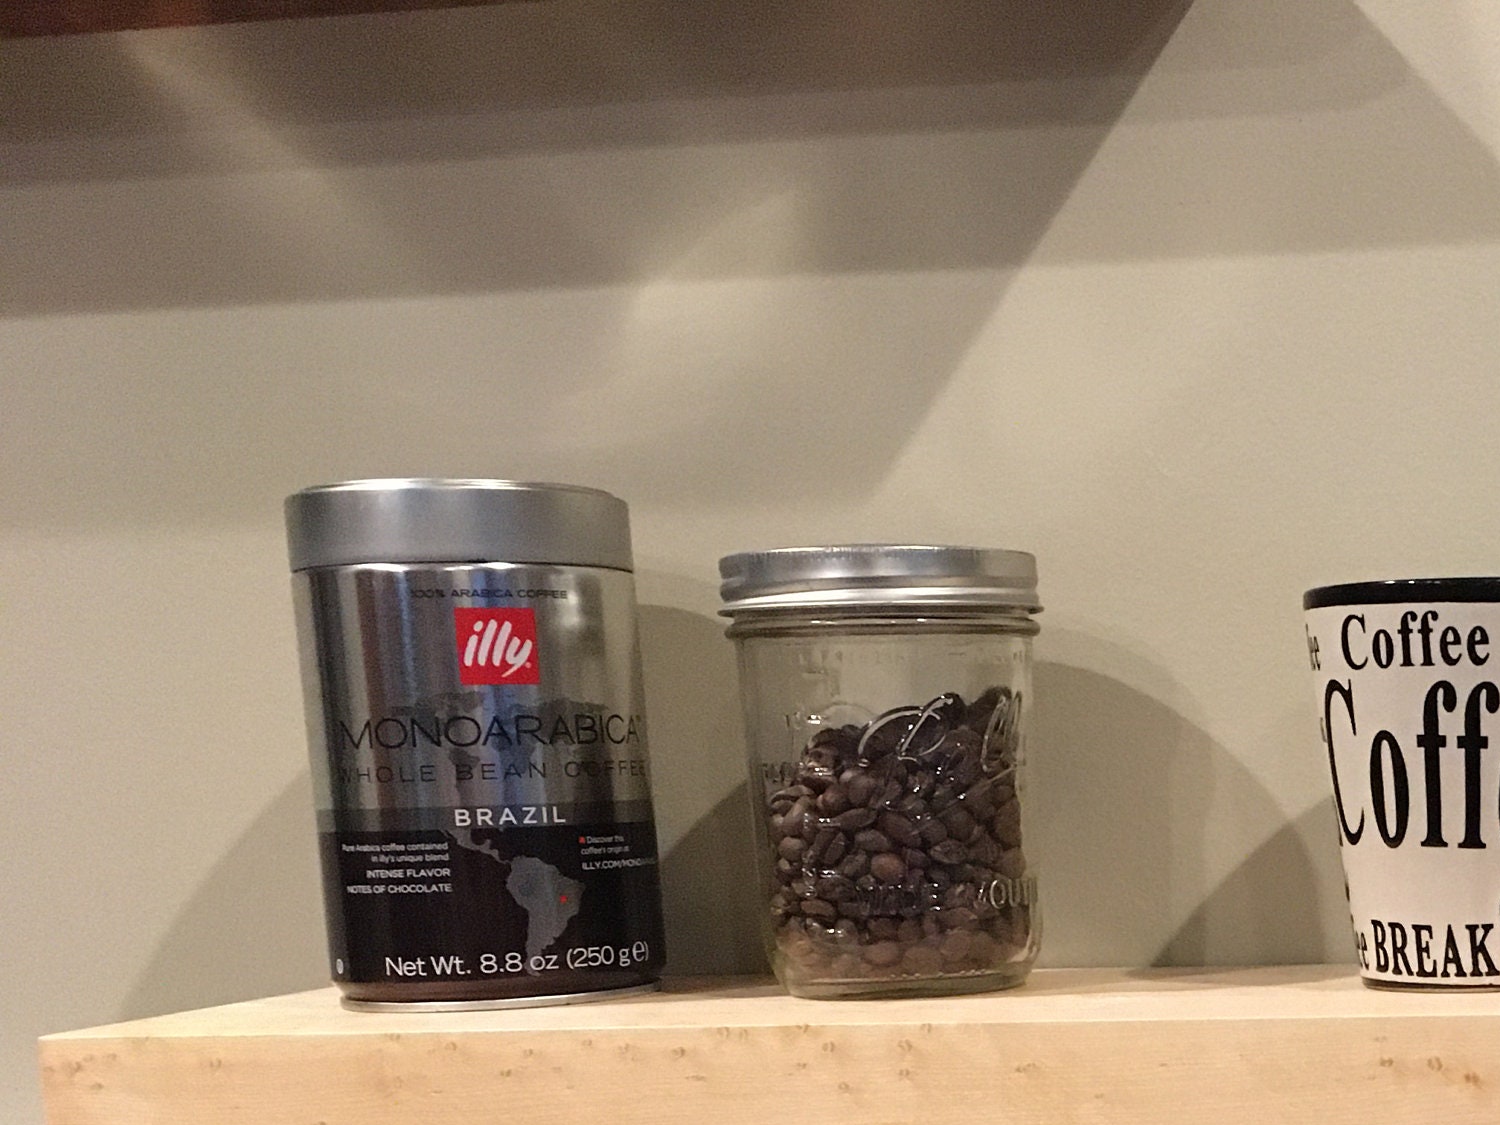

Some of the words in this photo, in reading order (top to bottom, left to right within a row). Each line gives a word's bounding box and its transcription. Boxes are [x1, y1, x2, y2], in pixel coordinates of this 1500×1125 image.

[450, 588, 514, 599] ARABICA
[516, 588, 569, 599] COFFEE
[463, 619, 533, 678] illy
[1340, 610, 1491, 671] Coffee
[340, 714, 641, 750] MONOARABICA
[456, 762, 546, 782] BEAN
[564, 760, 647, 779] COFFEE
[454, 806, 567, 827] BRAZIL
[406, 841, 449, 852] contained
[365, 868, 405, 879] INTENSE
[406, 867, 452, 878] FLAVOR
[346, 884, 373, 894] NOTES
[373, 884, 387, 894] OF
[387, 883, 454, 894] CHOCOLATE
[1371, 919, 1500, 979] BREAK
[384, 956, 428, 977] Net
[430, 955, 472, 976] Wt.
[479, 952, 524, 974] 8.8
[529, 954, 560, 972] oz
[566, 945, 615, 970] (250
